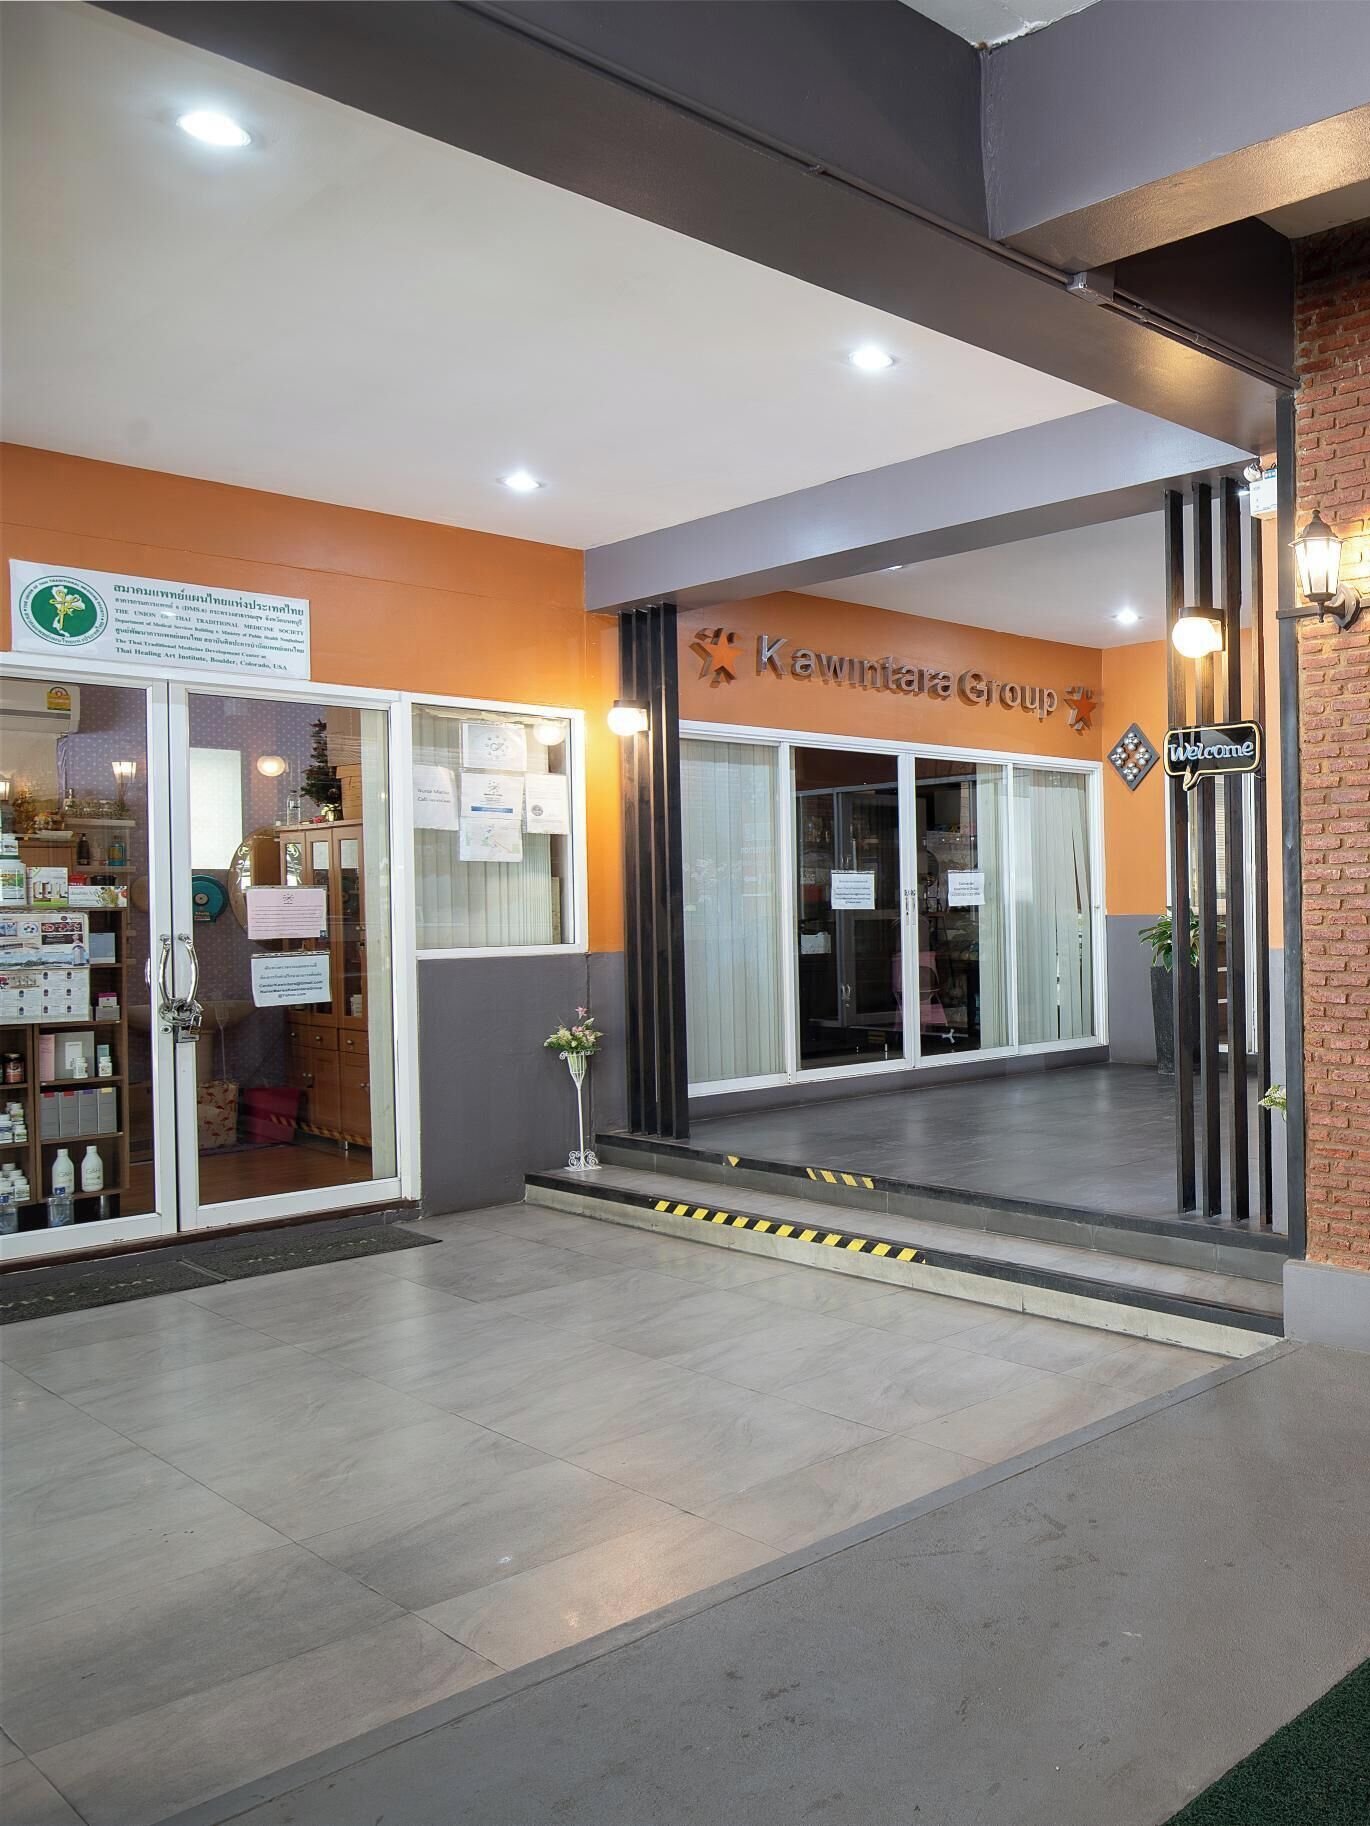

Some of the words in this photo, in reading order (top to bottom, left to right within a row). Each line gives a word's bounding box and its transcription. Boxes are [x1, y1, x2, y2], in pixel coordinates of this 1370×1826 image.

[195, 618, 239, 627] TRADITIONAL
[243, 623, 274, 631] MEDICINE
[278, 627, 304, 635] SOCIETY
[178, 653, 208, 661] Institute,
[757, 633, 955, 698] Kawintara
[957, 666, 1060, 723] Group
[1167, 741, 1255, 762] Welcome
